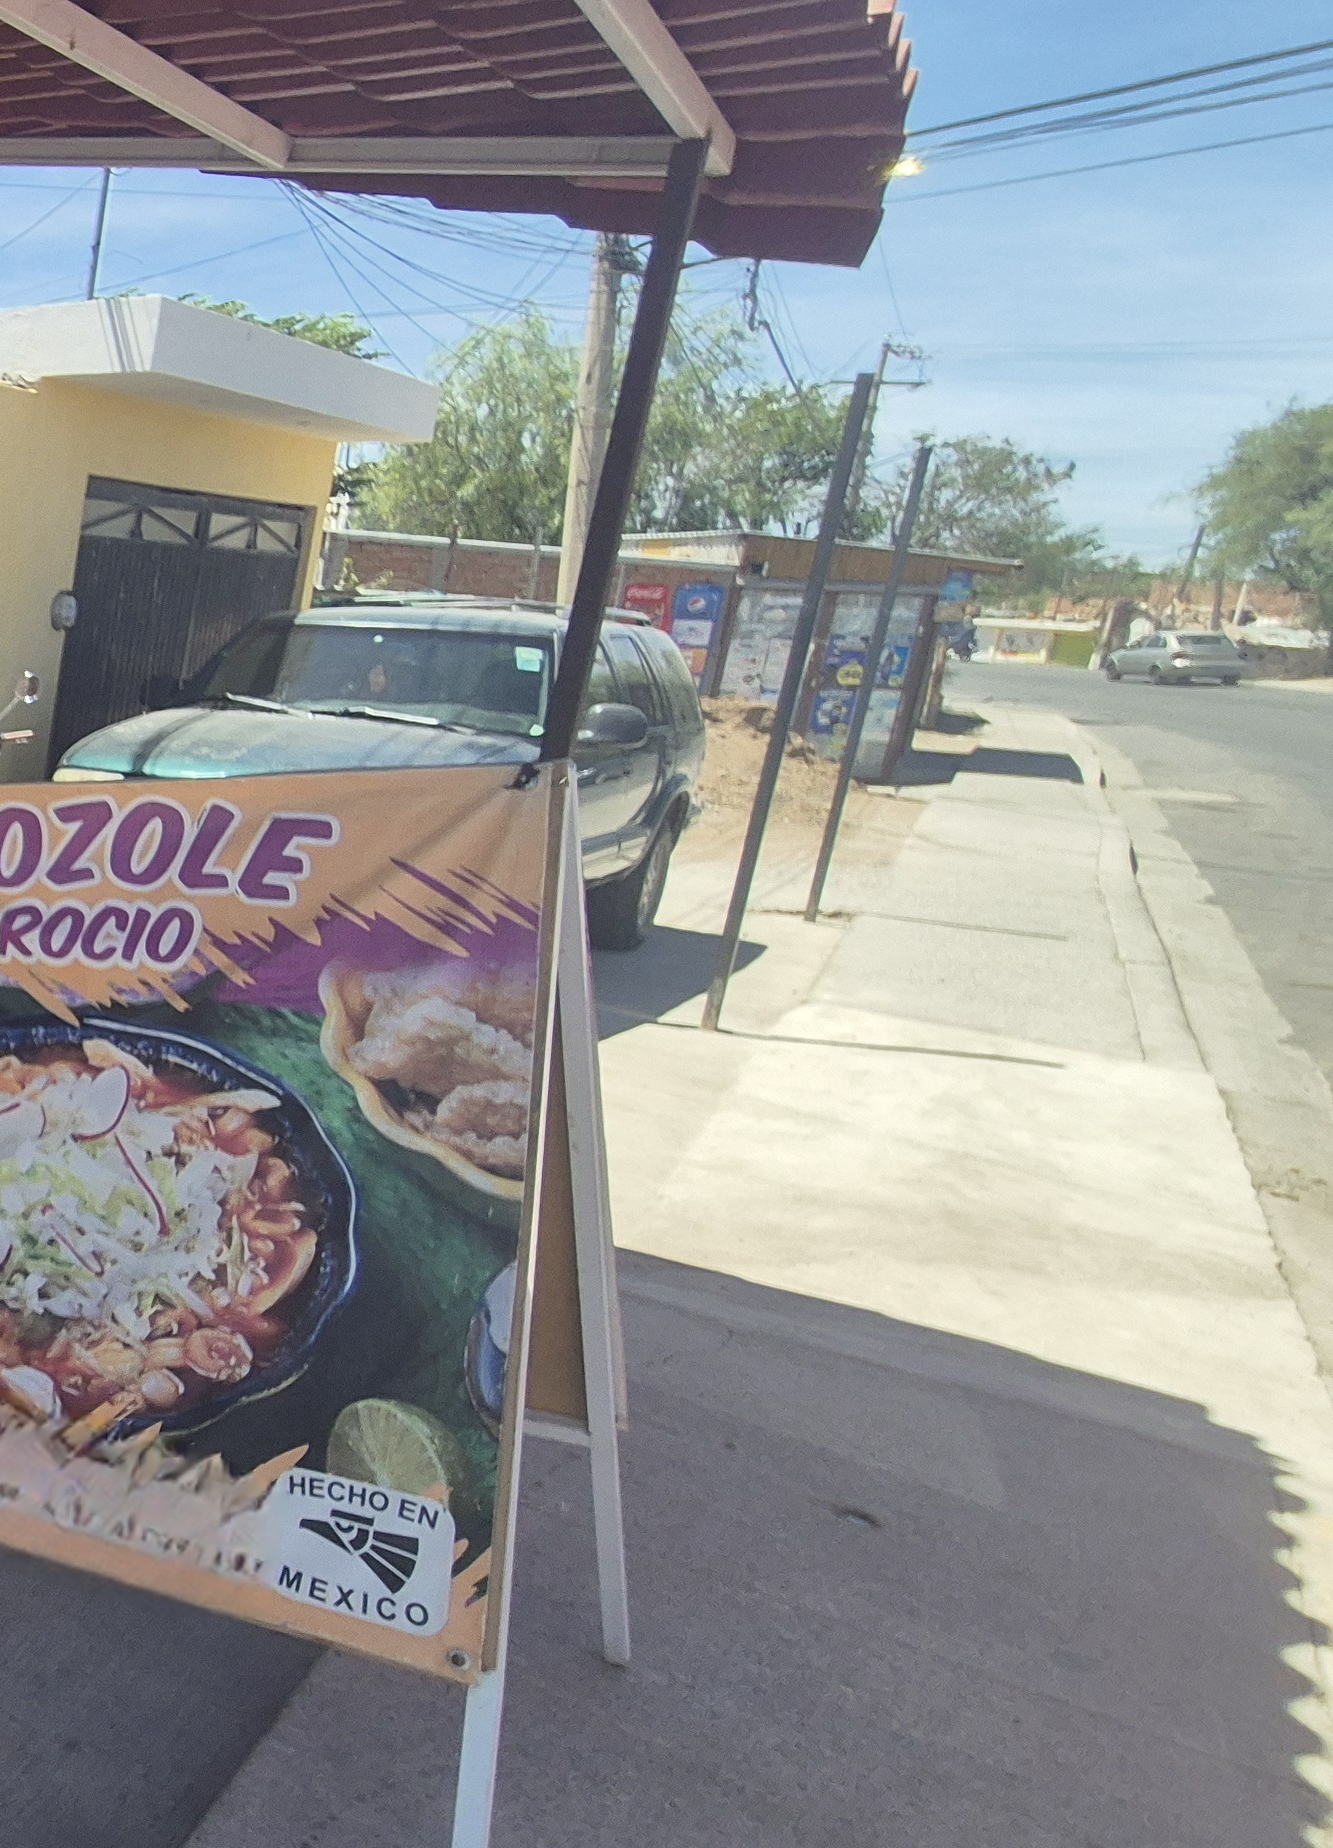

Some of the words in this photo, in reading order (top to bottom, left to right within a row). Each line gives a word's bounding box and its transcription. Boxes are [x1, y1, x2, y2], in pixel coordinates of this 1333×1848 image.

[288, 1474, 390, 1512] HECHO
[397, 1498, 441, 1531] EN
[277, 1565, 430, 1627] MEXICO
